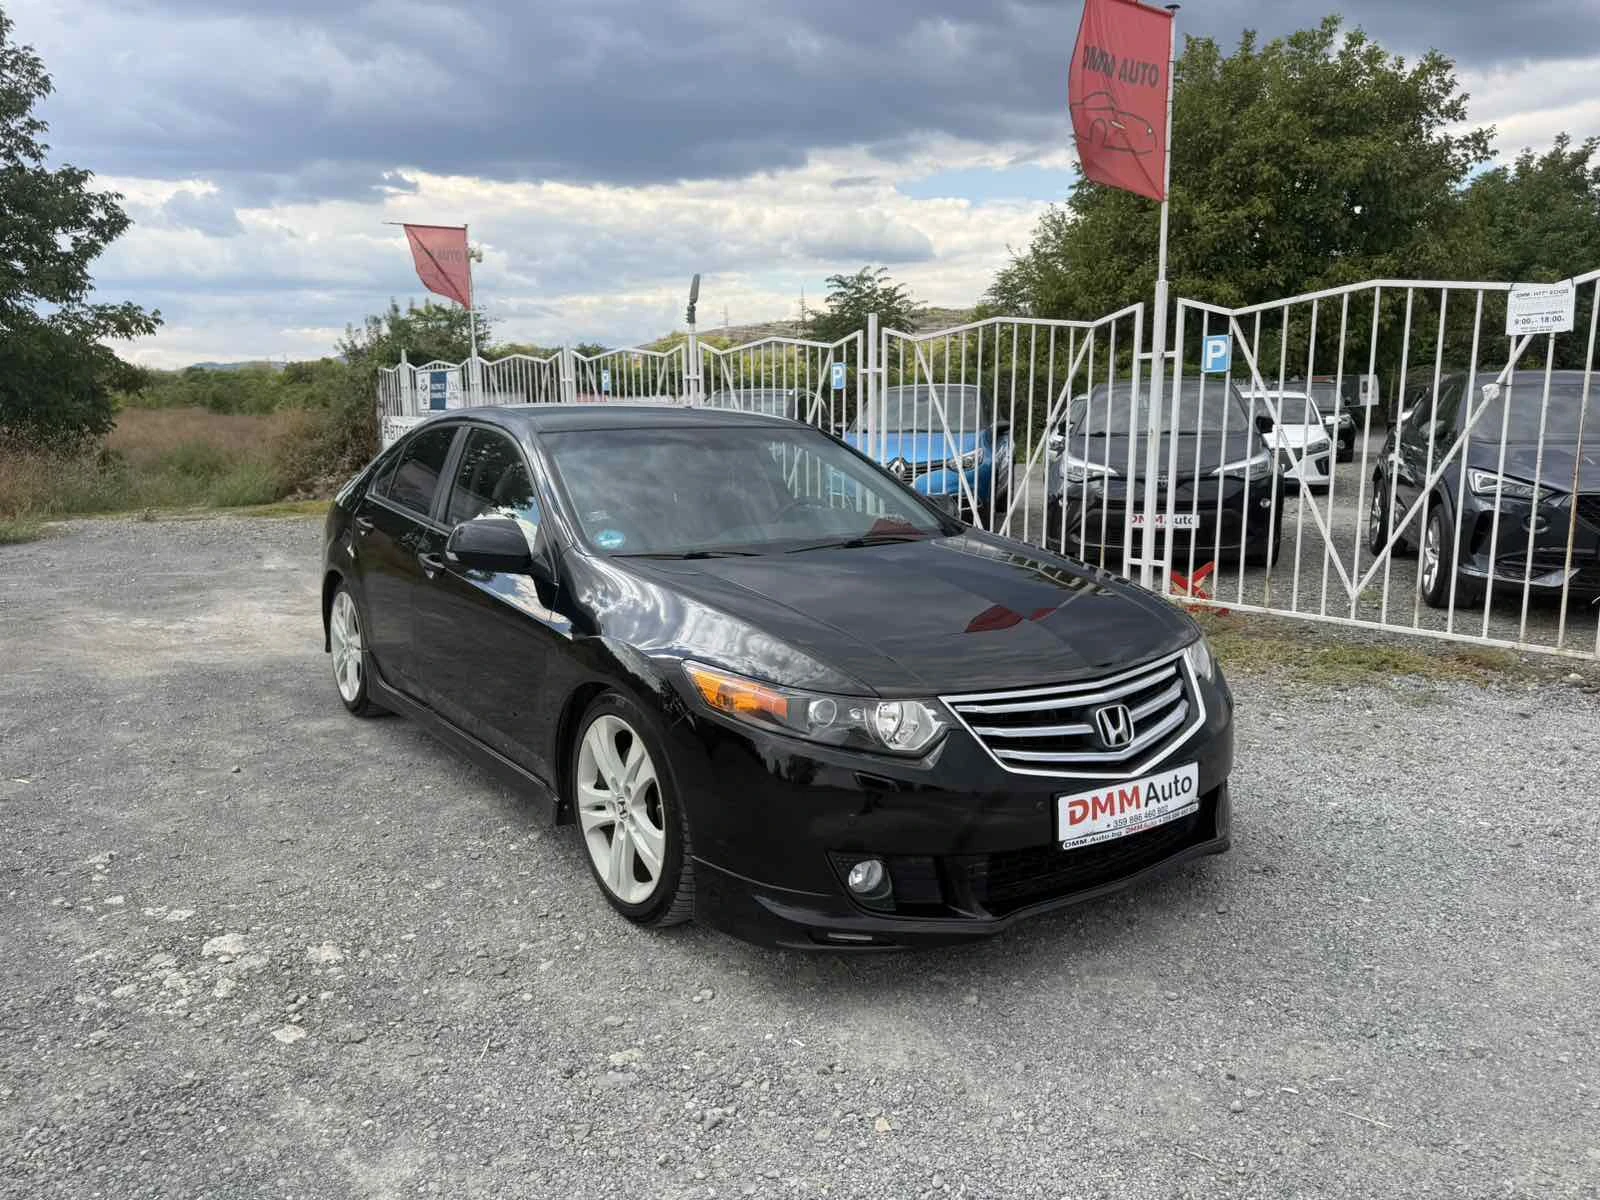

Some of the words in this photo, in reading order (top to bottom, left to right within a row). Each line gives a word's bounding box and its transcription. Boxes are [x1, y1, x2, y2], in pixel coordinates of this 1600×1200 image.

[1118, 58, 1159, 89] AUTO
[1206, 340, 1226, 369] P
[832, 366, 843, 387] P
[1068, 785, 1141, 825] DMM
[1144, 775, 1192, 807] Auto
